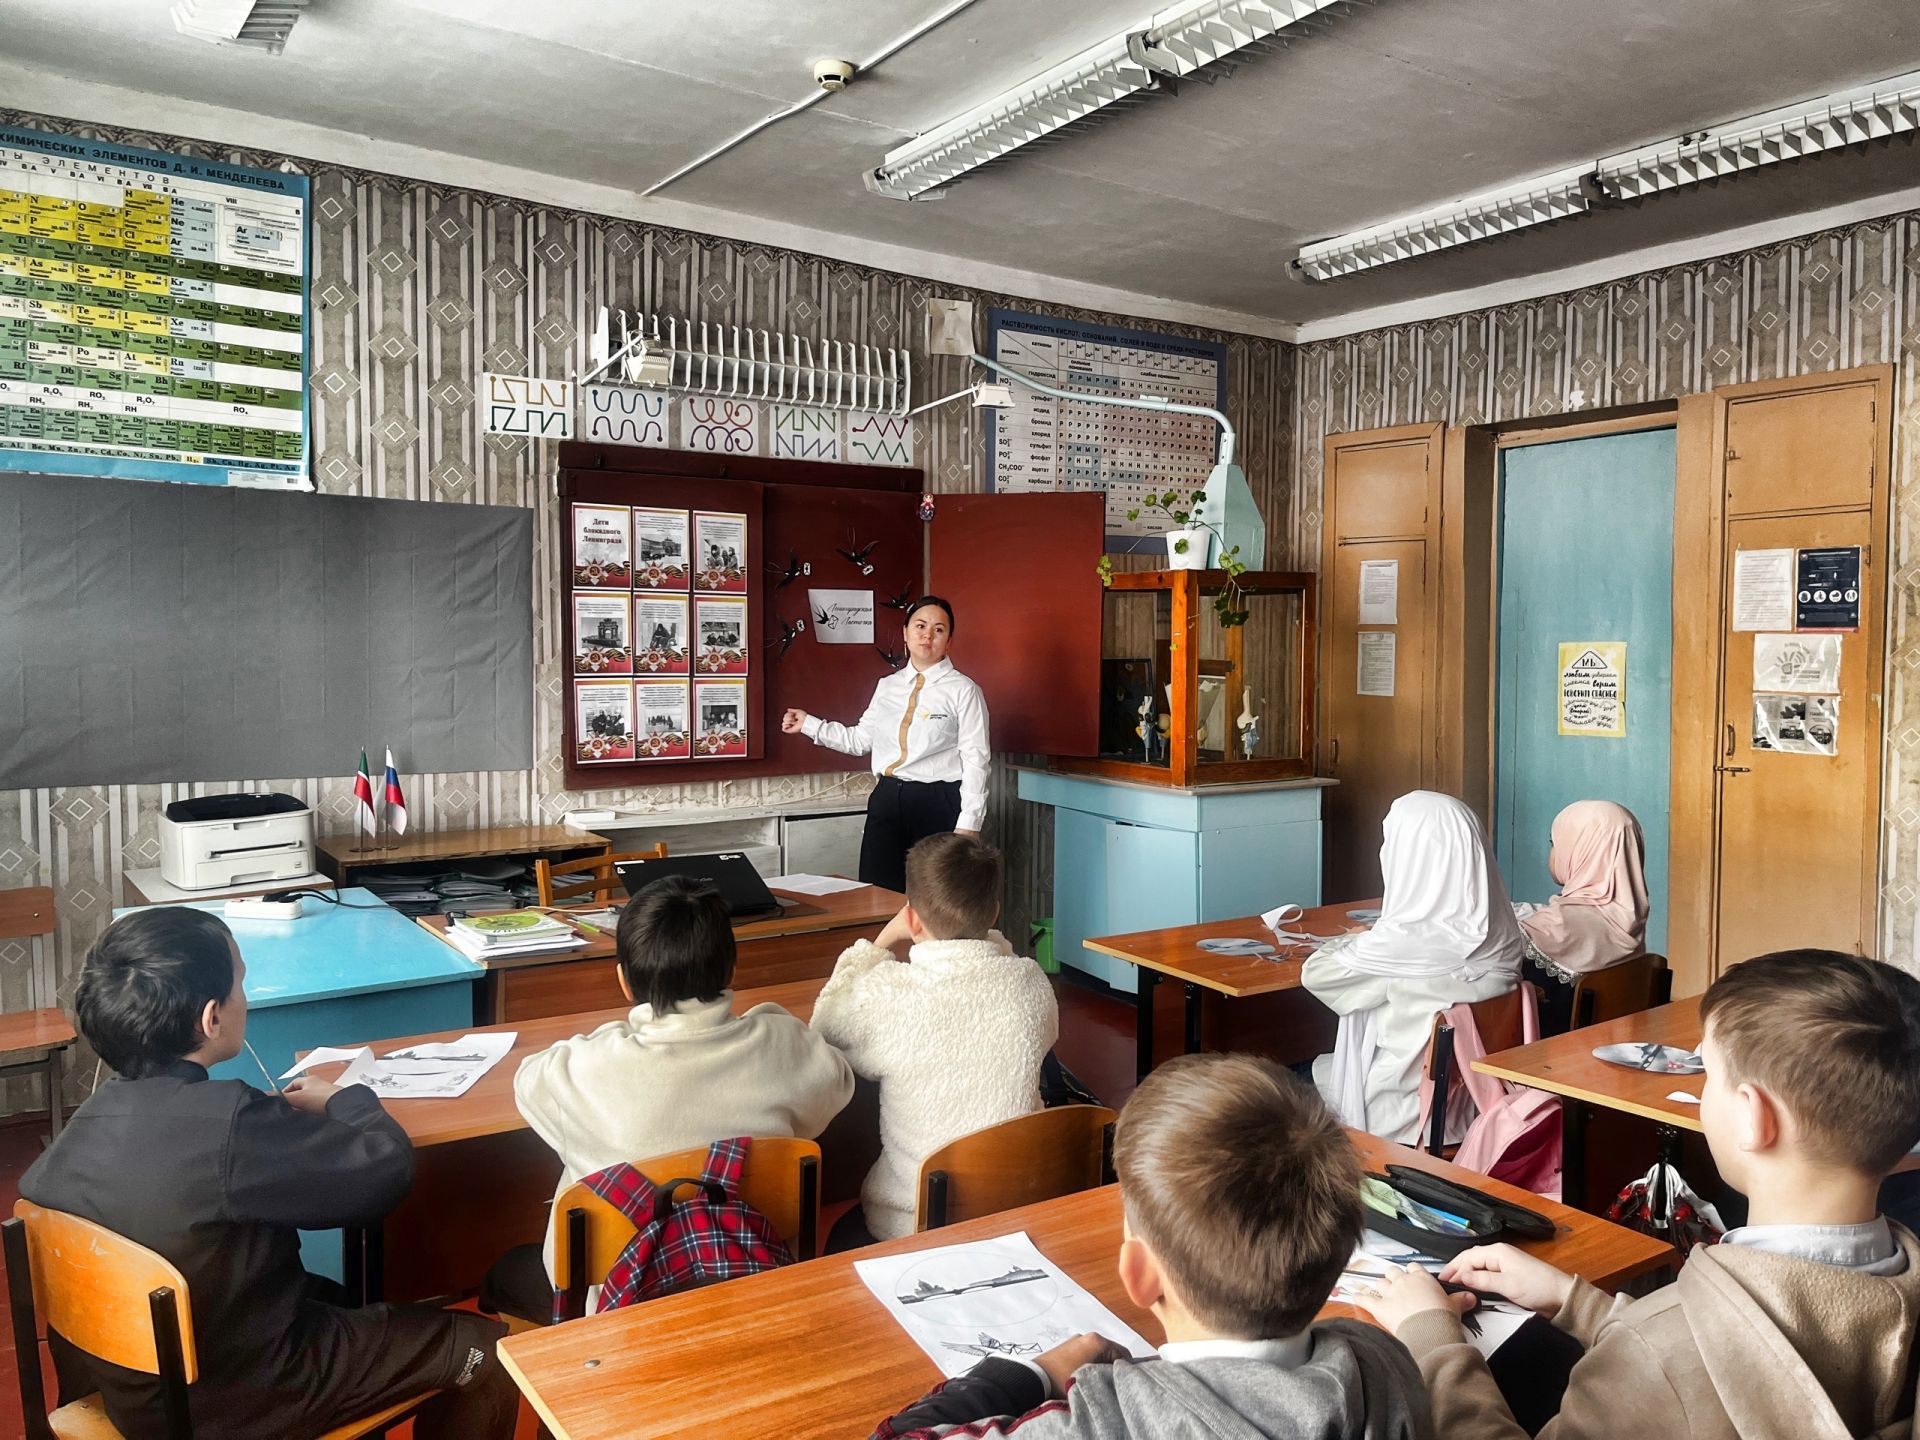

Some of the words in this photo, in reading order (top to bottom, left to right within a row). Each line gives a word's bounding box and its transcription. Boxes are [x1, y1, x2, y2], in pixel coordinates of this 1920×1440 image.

[93, 149, 167, 169] ЭЛЕМЕНТОВ
[173, 163, 187, 174] Д.
[191, 166, 203, 175] И.
[206, 169, 285, 190] МЕНДЕЛЕЕВА
[31, 196, 39, 204] N
[171, 197, 185, 206] He
[78, 202, 87, 211] O
[125, 210, 132, 218] F
[30, 216, 38, 225] P
[171, 217, 185, 226] Ne
[78, 223, 85, 232] S
[236, 226, 248, 235] Ar
[171, 238, 182, 246] Ar
[110, 250, 123, 258] Cr
[30, 259, 43, 268] As
[78, 265, 90, 274] Se
[125, 272, 137, 280] Br
[15, 278, 27, 287] Zr
[171, 277, 184, 287] Kr
[107, 290, 123, 298] Mo
[29, 300, 42, 309] Sb
[77, 306, 90, 315] Te
[170, 317, 184, 326] Xe
[1001, 319, 1055, 333] РАСТВОРИМОСТЬ
[1121, 337, 1140, 347] СОЛЕЙ
[155, 336, 168, 345] Re
[29, 342, 39, 350] Bi
[77, 347, 90, 355] Po
[170, 358, 183, 366] Rn
[124, 405, 137, 413] RH
[592, 518, 609, 526] Дети
[583, 526, 621, 535] блокадного
[582, 535, 622, 545] Ленинграда
[1564, 670, 1590, 678] любим
[1592, 680, 1616, 689] верим
[1564, 689, 1591, 698] ГОВОРИМ
[1592, 689, 1617, 698] СПАСИБО
